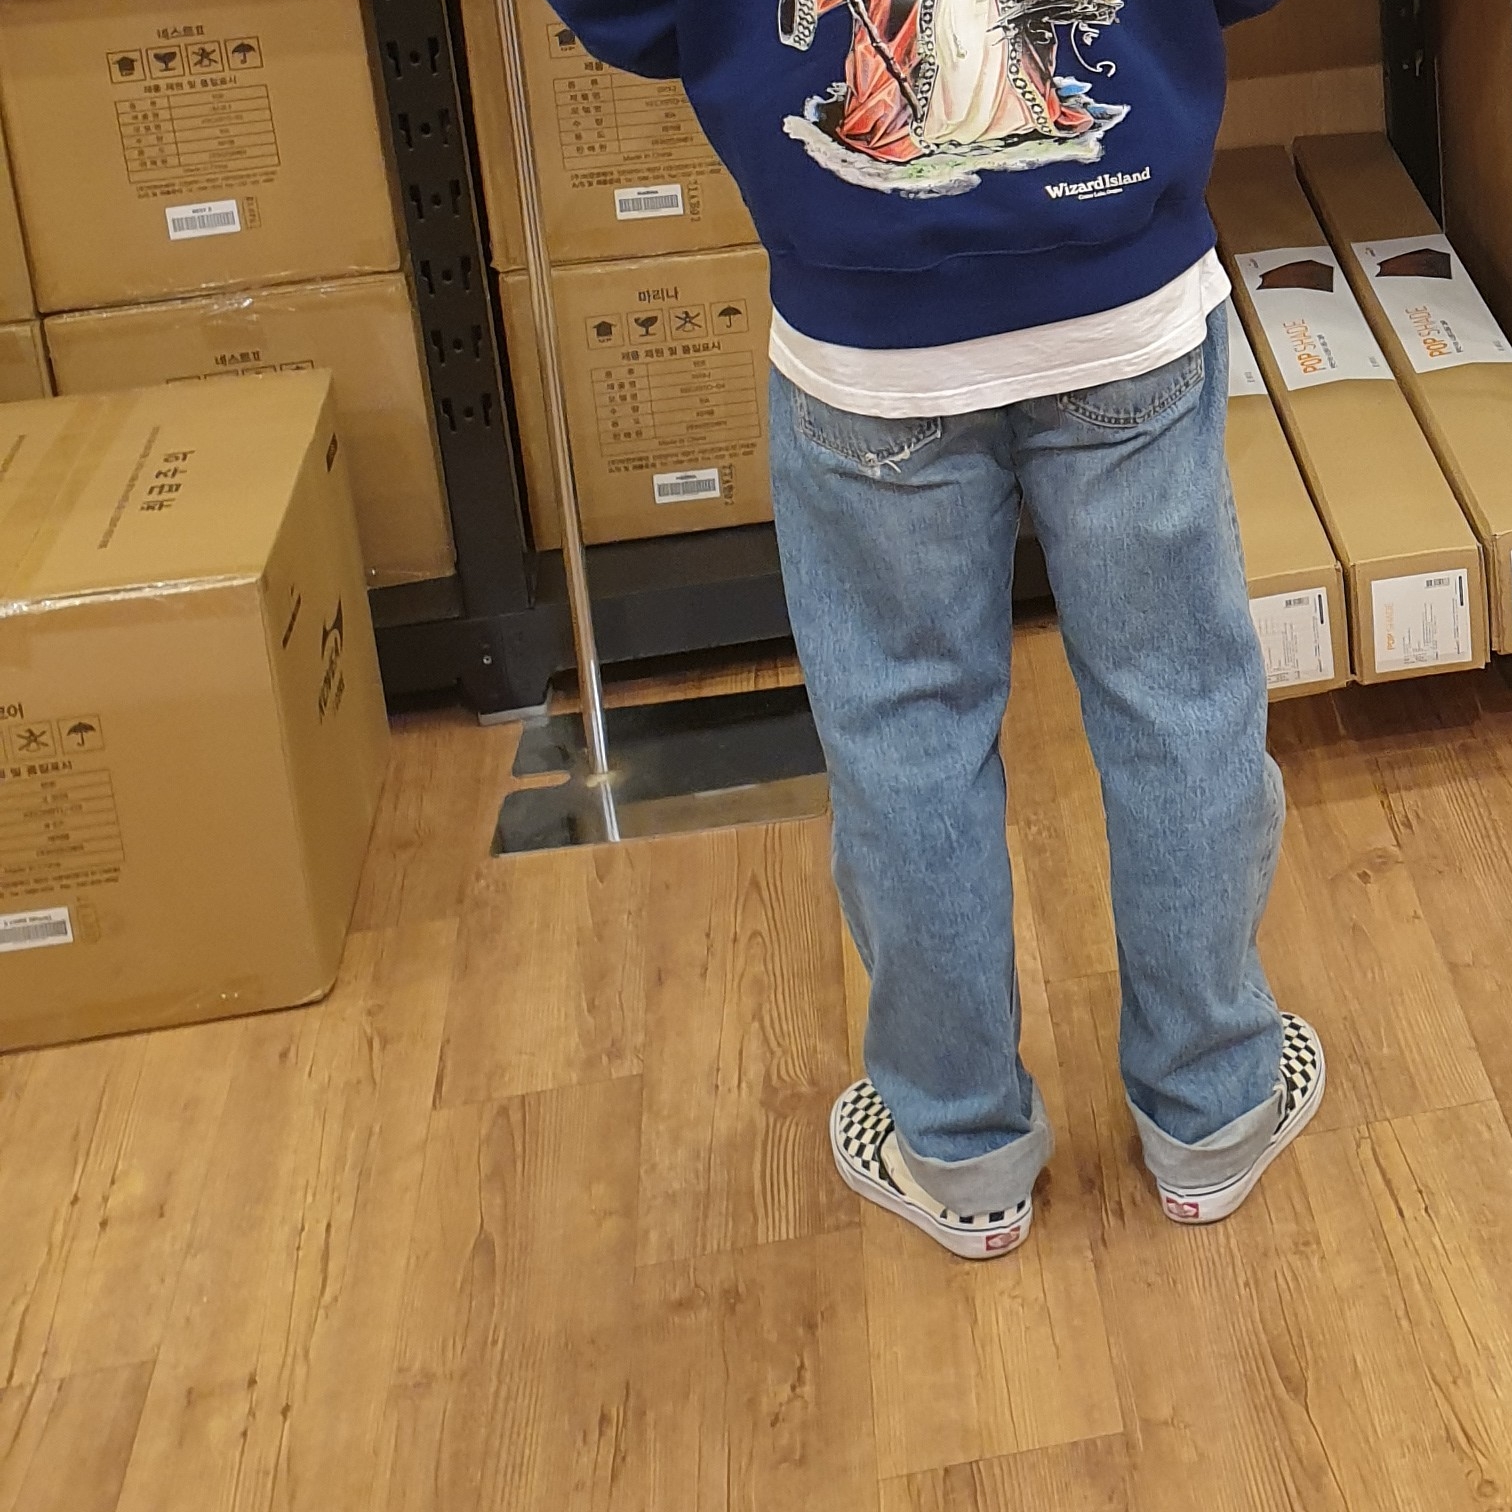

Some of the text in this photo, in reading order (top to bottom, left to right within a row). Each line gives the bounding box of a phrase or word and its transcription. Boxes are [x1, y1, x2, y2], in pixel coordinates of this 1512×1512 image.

[1045, 166, 1152, 200] Wizard Island
[637, 287, 680, 304] 마리나
[1422, 334, 1454, 359] POP
[1296, 349, 1325, 375] POP
[140, 449, 197, 513] 취급주의
